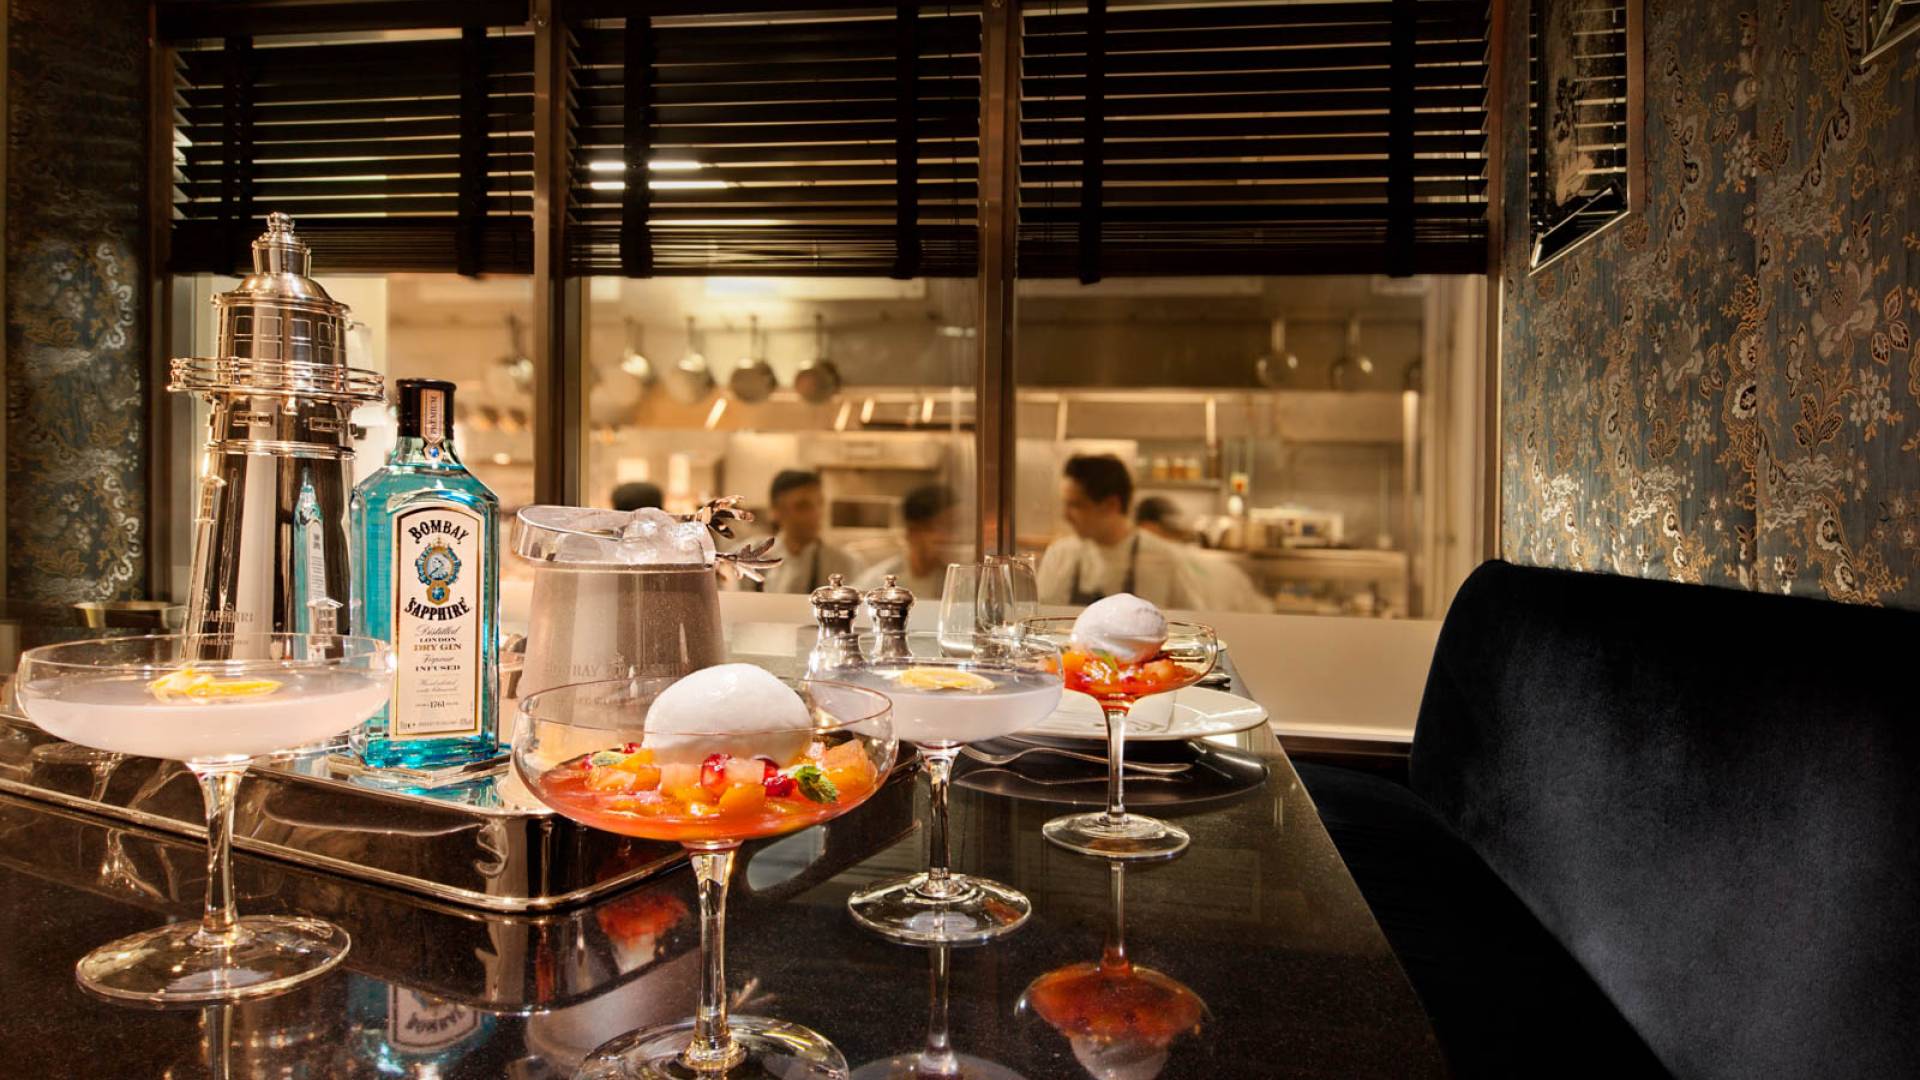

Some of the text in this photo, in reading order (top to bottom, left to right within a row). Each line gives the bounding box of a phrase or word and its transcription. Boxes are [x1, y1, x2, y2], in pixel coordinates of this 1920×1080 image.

[408, 519, 470, 545] BOMBAY
[404, 596, 471, 621] SAPPHIRE
[413, 643, 462, 652] DRY GIN
